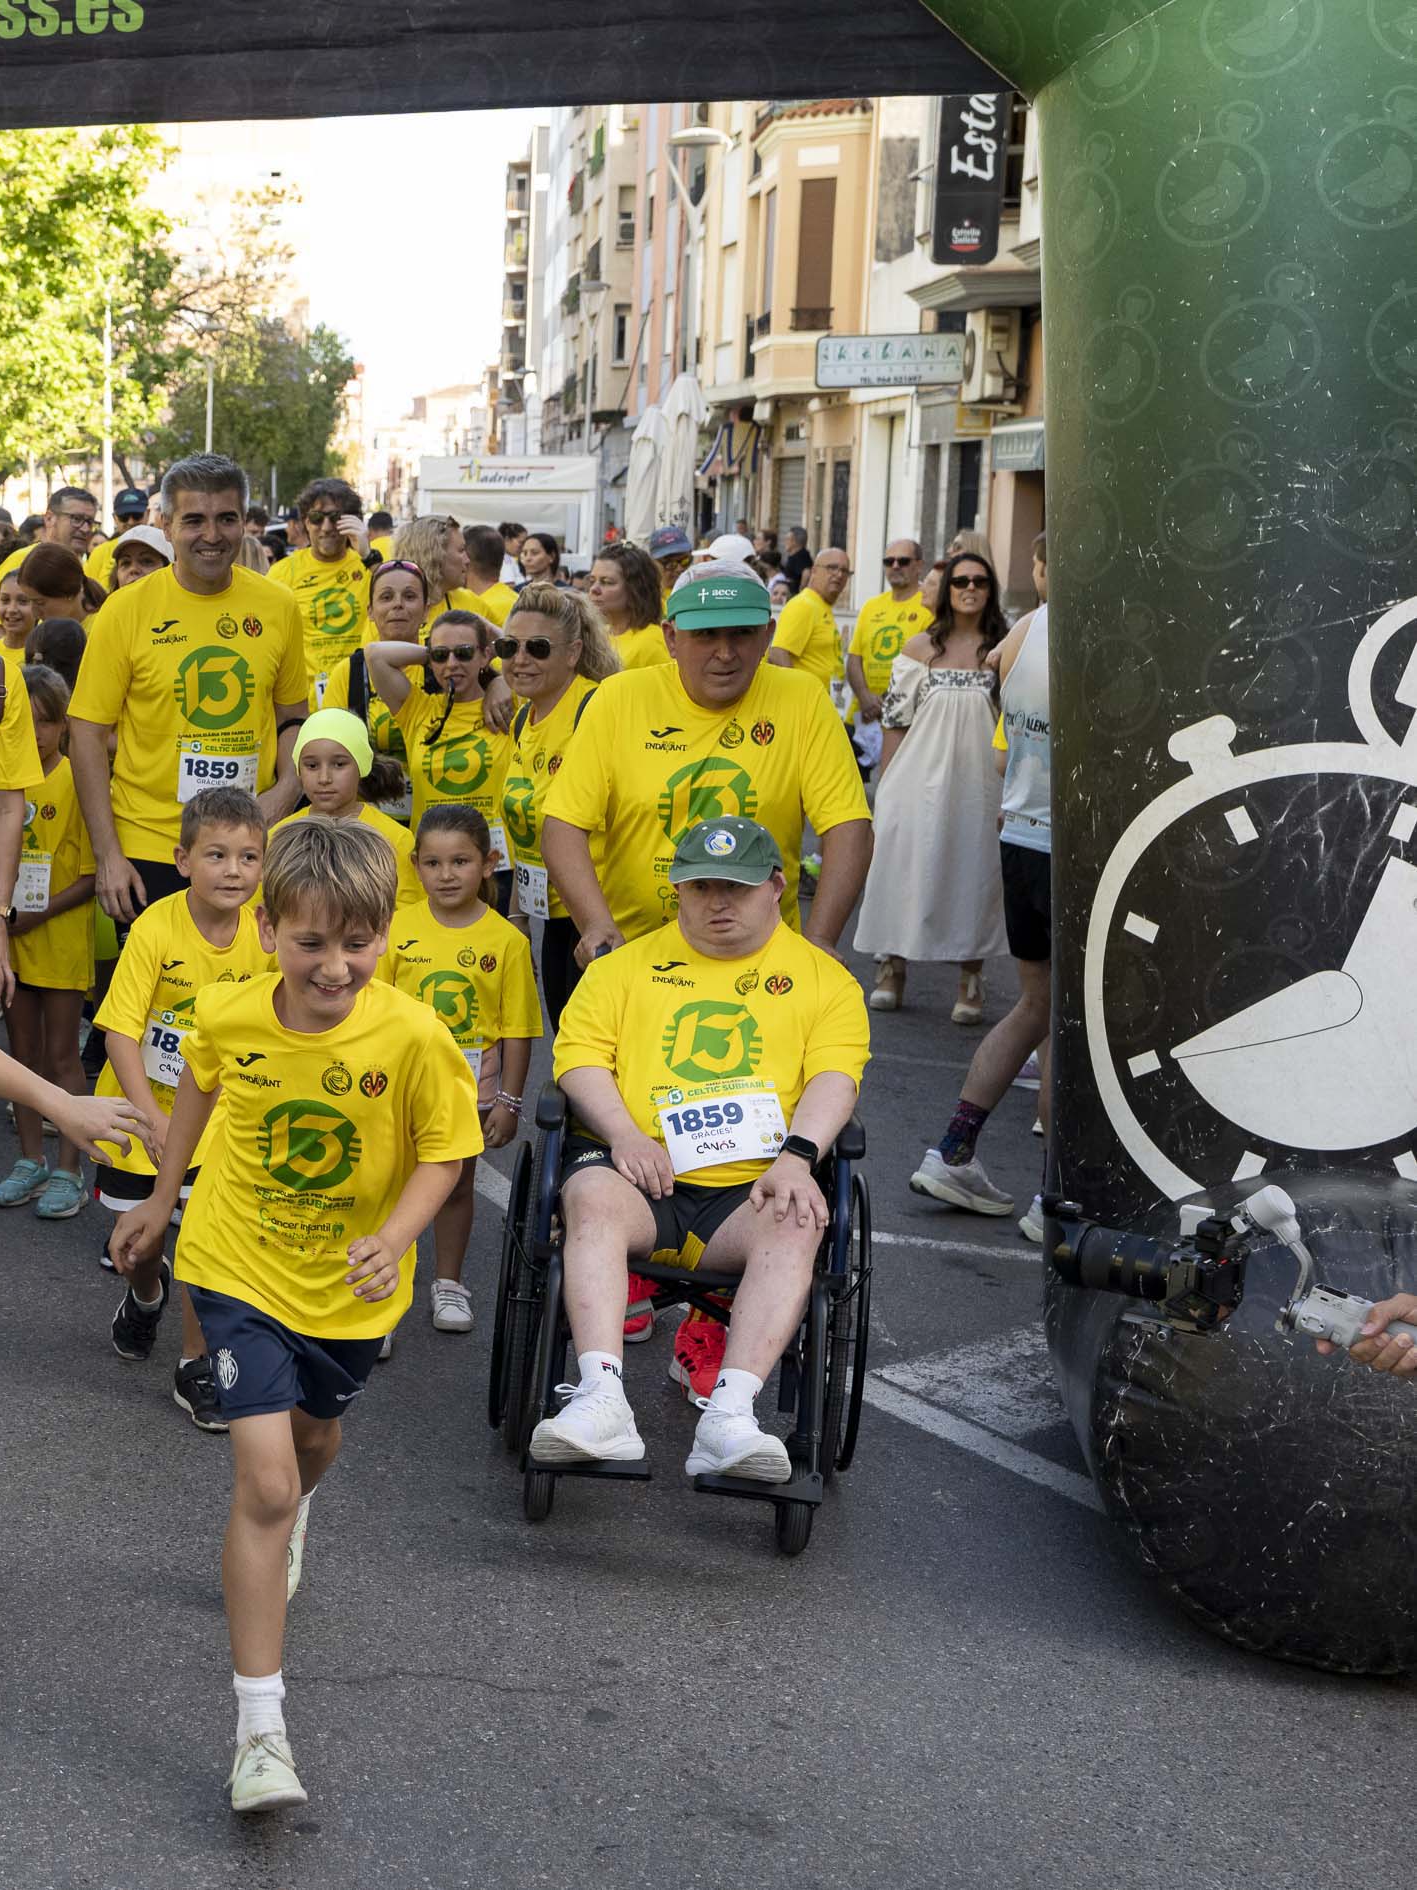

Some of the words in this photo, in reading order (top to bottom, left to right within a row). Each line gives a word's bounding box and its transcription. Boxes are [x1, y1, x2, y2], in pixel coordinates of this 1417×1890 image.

[185, 758, 239, 779] 1859
[159, 1063, 181, 1077] CAN
[238, 1072, 282, 1089] ENDAVANT
[687, 1086, 720, 1097] CELTIC
[667, 1102, 743, 1136] 1859
[300, 1222, 331, 1234] infantil
